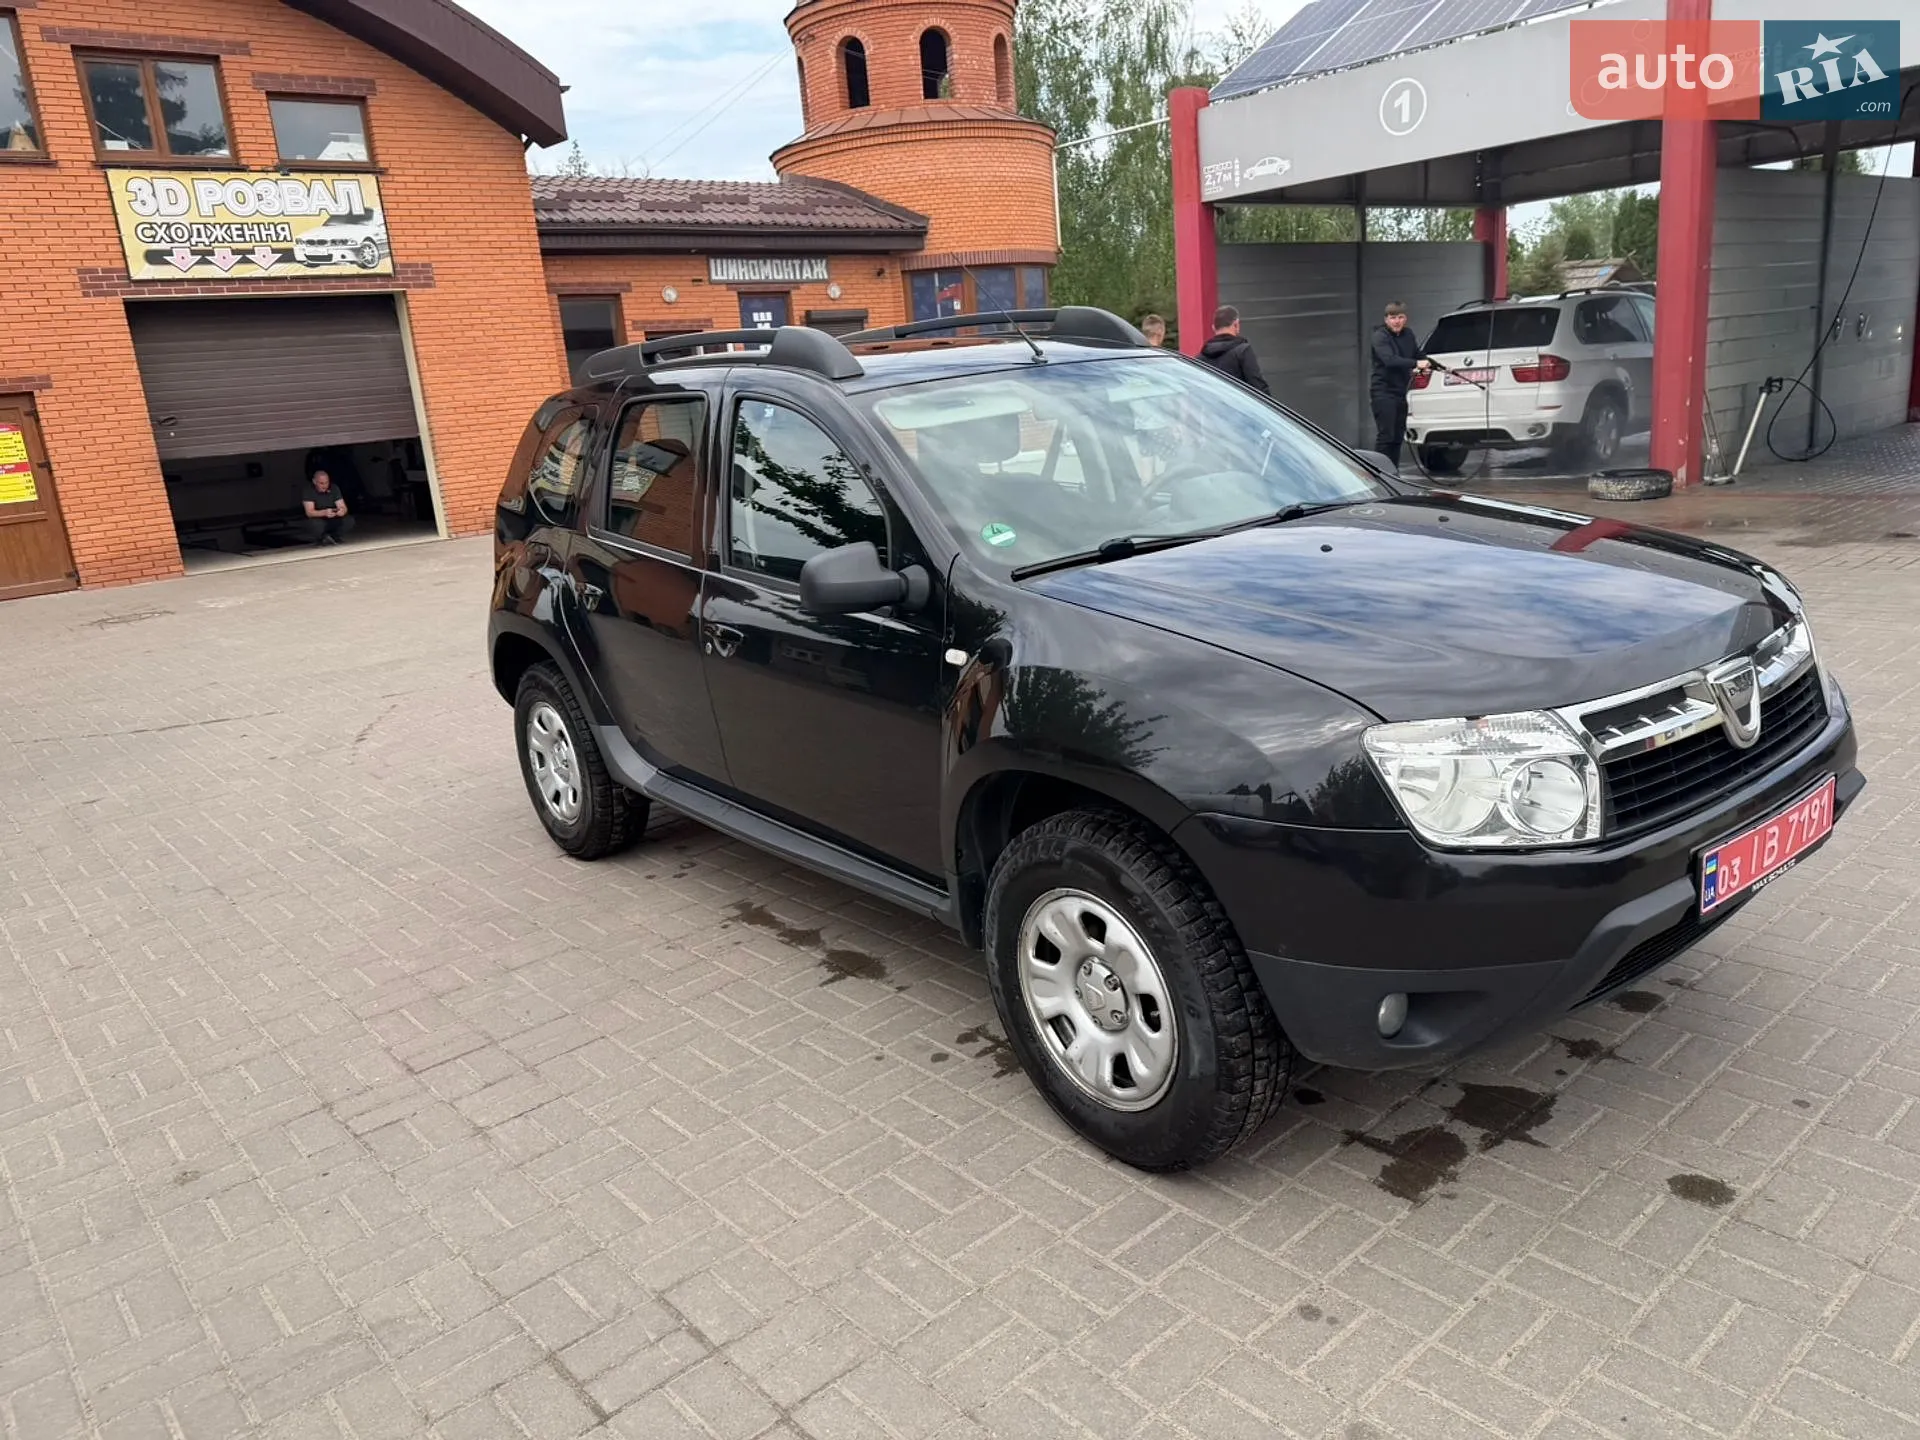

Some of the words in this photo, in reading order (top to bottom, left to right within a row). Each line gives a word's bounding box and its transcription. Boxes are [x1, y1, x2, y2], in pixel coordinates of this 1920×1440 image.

[1394, 89, 1411, 124] 1
[126, 176, 192, 217] 3D
[193, 178, 365, 217] РОЗВАЛ
[135, 221, 292, 247] СХОДЖЕННЯ
[709, 258, 829, 280] ШИНОМОНТАЖ
[1718, 856, 1742, 895] 03
[1750, 825, 1779, 875] IB
